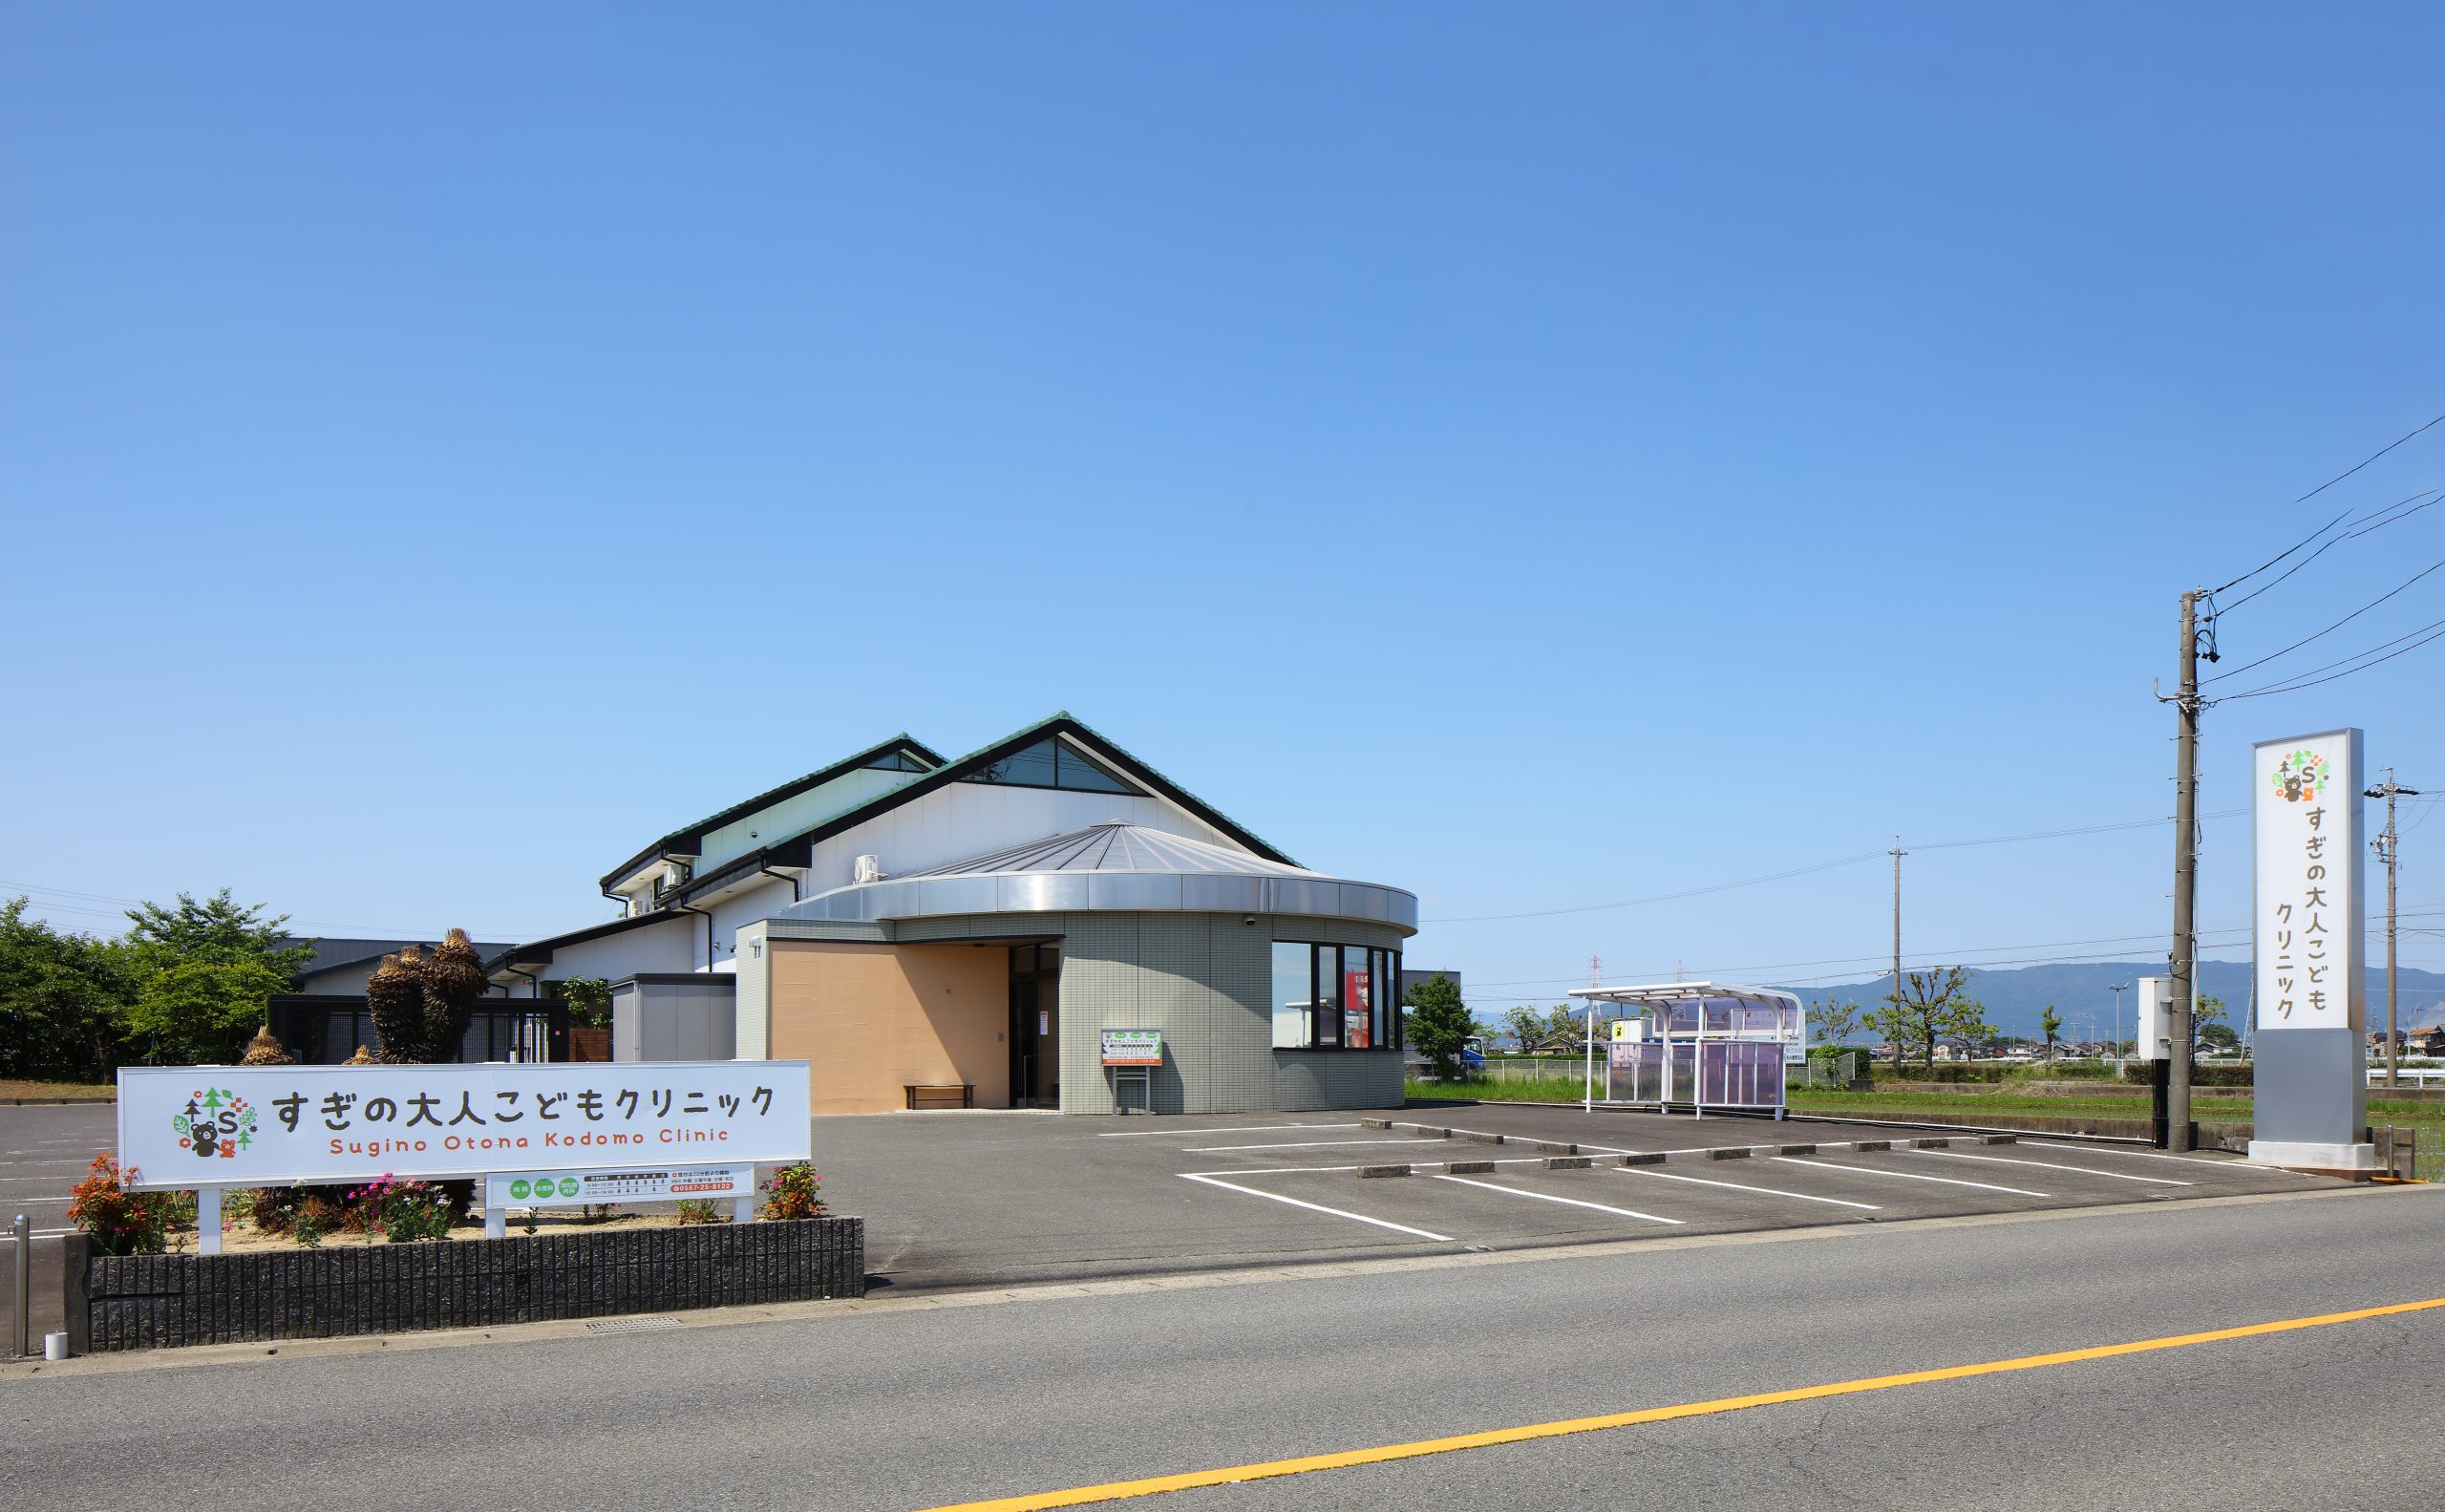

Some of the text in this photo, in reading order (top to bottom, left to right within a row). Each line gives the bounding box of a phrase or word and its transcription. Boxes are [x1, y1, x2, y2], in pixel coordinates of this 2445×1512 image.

[2305, 806, 2328, 1011] すぎの大人こども
[2276, 903, 2294, 1020] クリニック
[218, 1111, 239, 1135] S
[271, 1086, 773, 1133] すぎの大人こどもクリニック
[330, 1128, 728, 1157] Sugino Otona Kodomo Clinic
